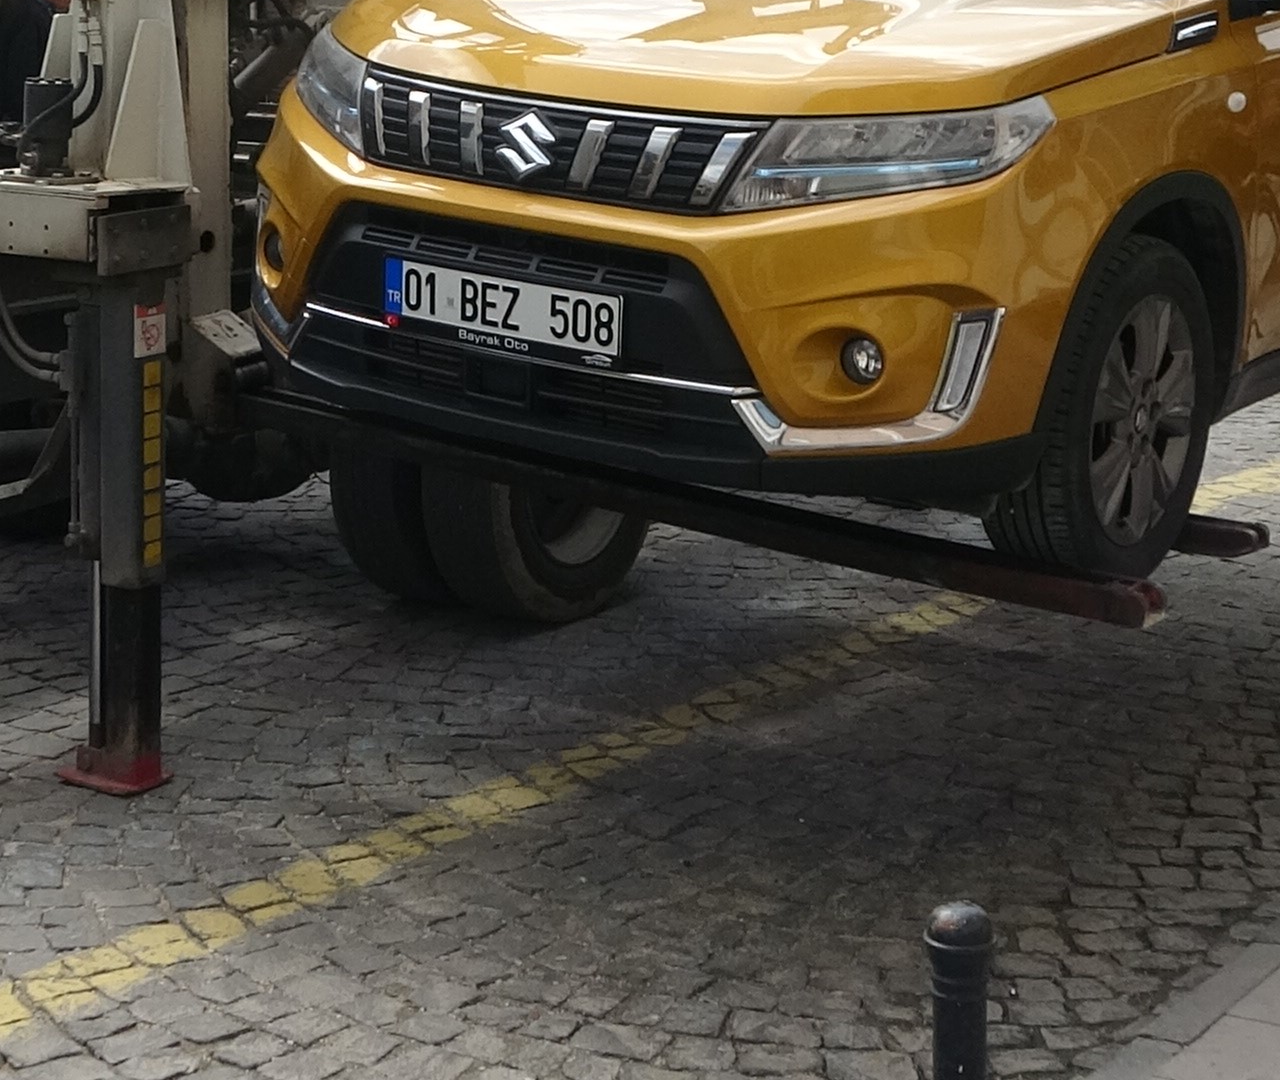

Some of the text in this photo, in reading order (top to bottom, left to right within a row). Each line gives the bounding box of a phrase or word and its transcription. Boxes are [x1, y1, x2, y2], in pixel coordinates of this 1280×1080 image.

[387, 268, 615, 347] TR 01 BEZ 508
[458, 328, 529, 352] Bayrak Oto
